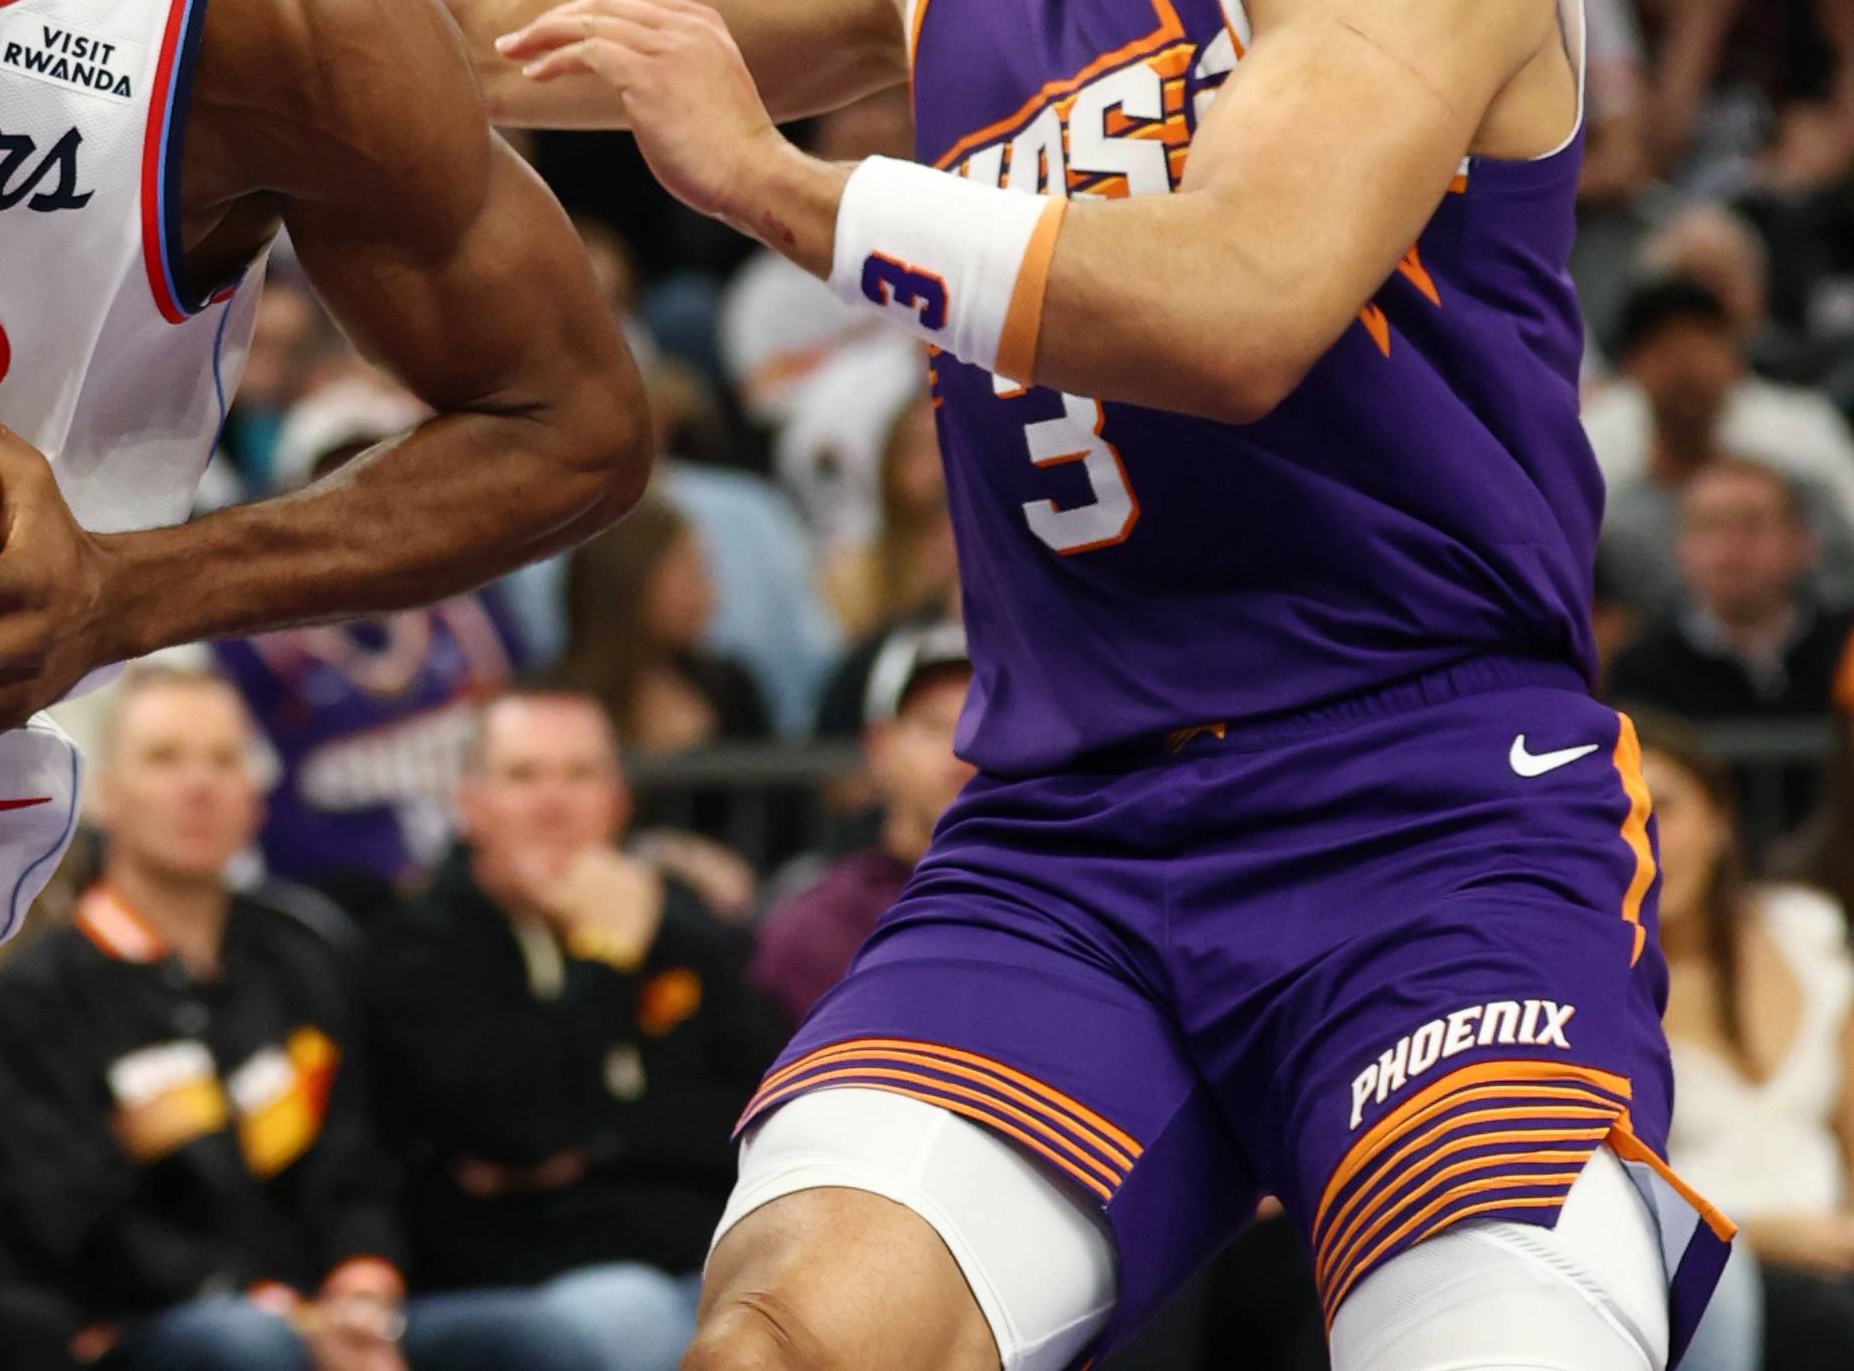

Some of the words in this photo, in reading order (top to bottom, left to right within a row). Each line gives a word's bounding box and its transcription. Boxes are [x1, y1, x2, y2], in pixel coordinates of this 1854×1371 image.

[3, 41, 131, 98] RWANDA
[43, 25, 116, 65] VISIT
[860, 249, 949, 331] 3
[991, 372, 1141, 555] 3
[1349, 999, 1576, 1130] PHOENIX
